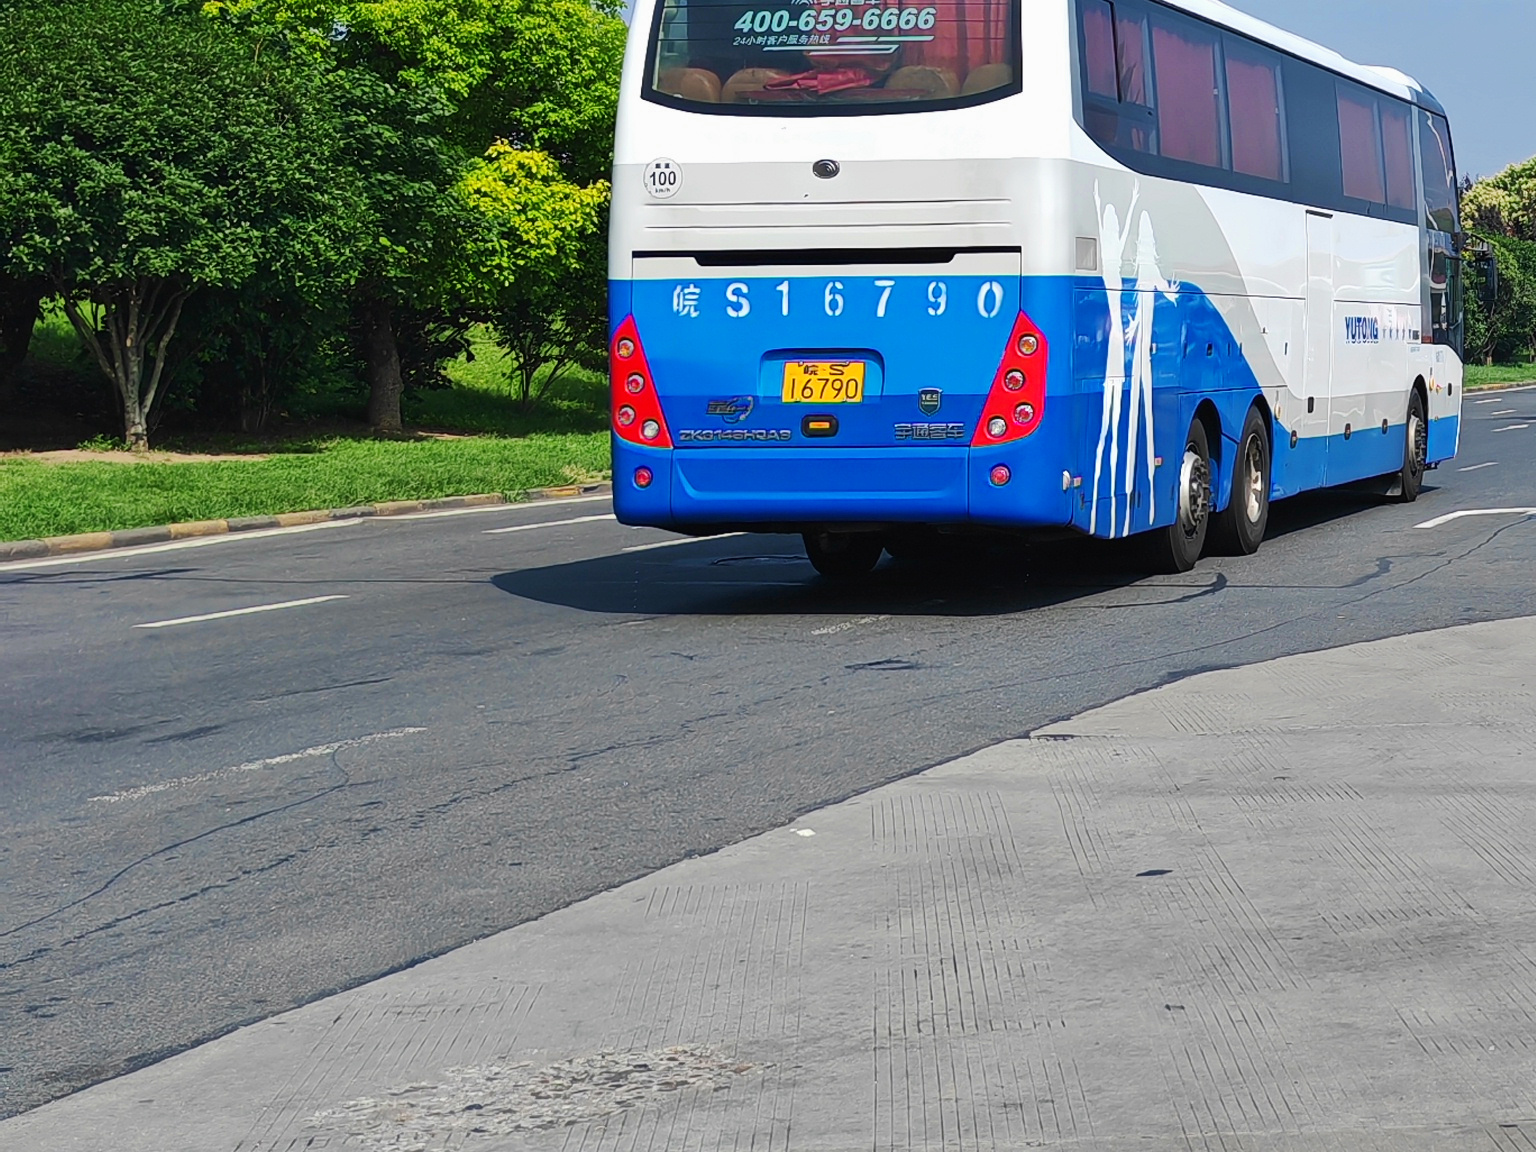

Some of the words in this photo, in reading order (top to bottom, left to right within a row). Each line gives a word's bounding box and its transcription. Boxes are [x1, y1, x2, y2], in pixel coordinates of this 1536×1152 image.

[734, 7, 937, 33] 400-659-6666
[650, 171, 676, 186] 100
[1344, 316, 1379, 343] YUTONG
[791, 378, 858, 399] 16790
[894, 423, 965, 439] 宇通客车
